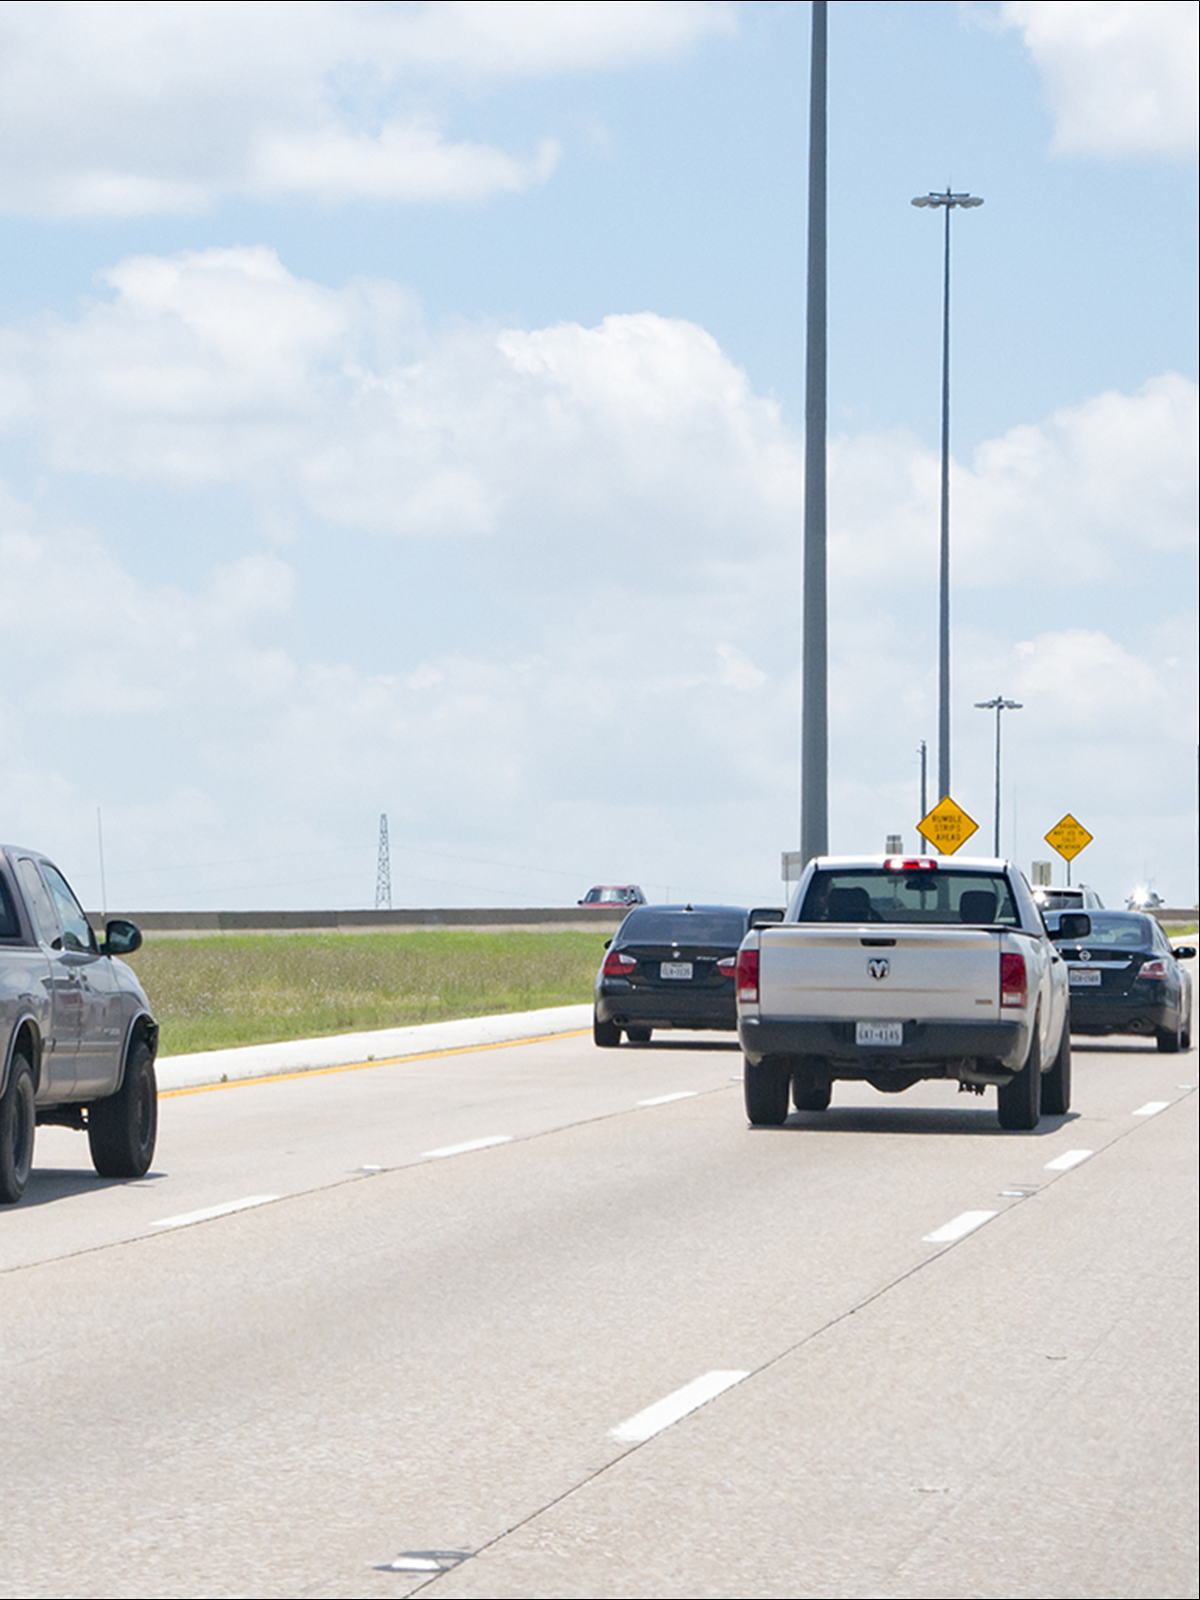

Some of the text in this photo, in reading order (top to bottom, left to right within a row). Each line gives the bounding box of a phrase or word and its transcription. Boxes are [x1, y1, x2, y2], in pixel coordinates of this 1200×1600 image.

[932, 814, 962, 823] RUMBLE
[934, 824, 961, 832] STRIPS
[935, 833, 961, 842] AHEAD
